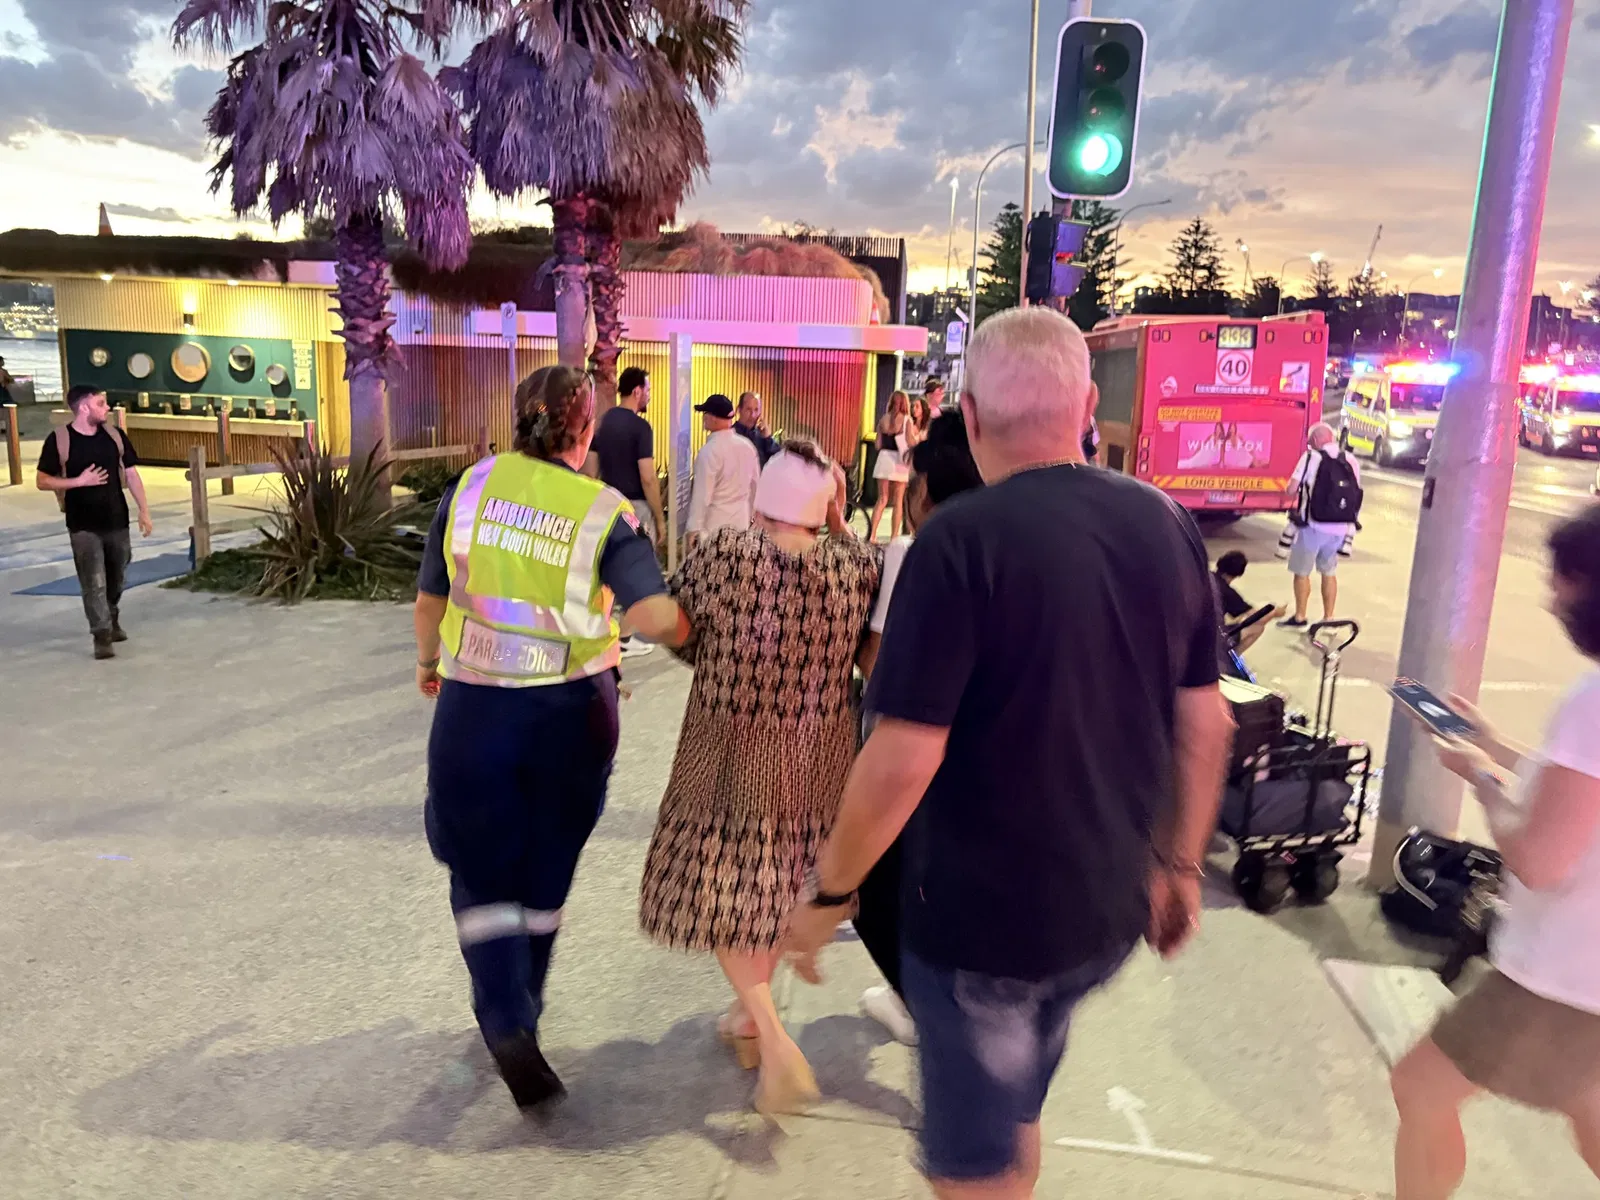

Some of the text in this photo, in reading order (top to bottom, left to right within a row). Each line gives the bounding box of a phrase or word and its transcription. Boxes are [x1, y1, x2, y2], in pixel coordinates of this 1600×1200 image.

[1222, 360, 1247, 376] 40
[1187, 440, 1264, 452] WHITE FOX
[1184, 479, 1264, 489] LONG VEHICLE
[481, 497, 577, 543] AMBULANCE
[533, 537, 570, 568] WALES
